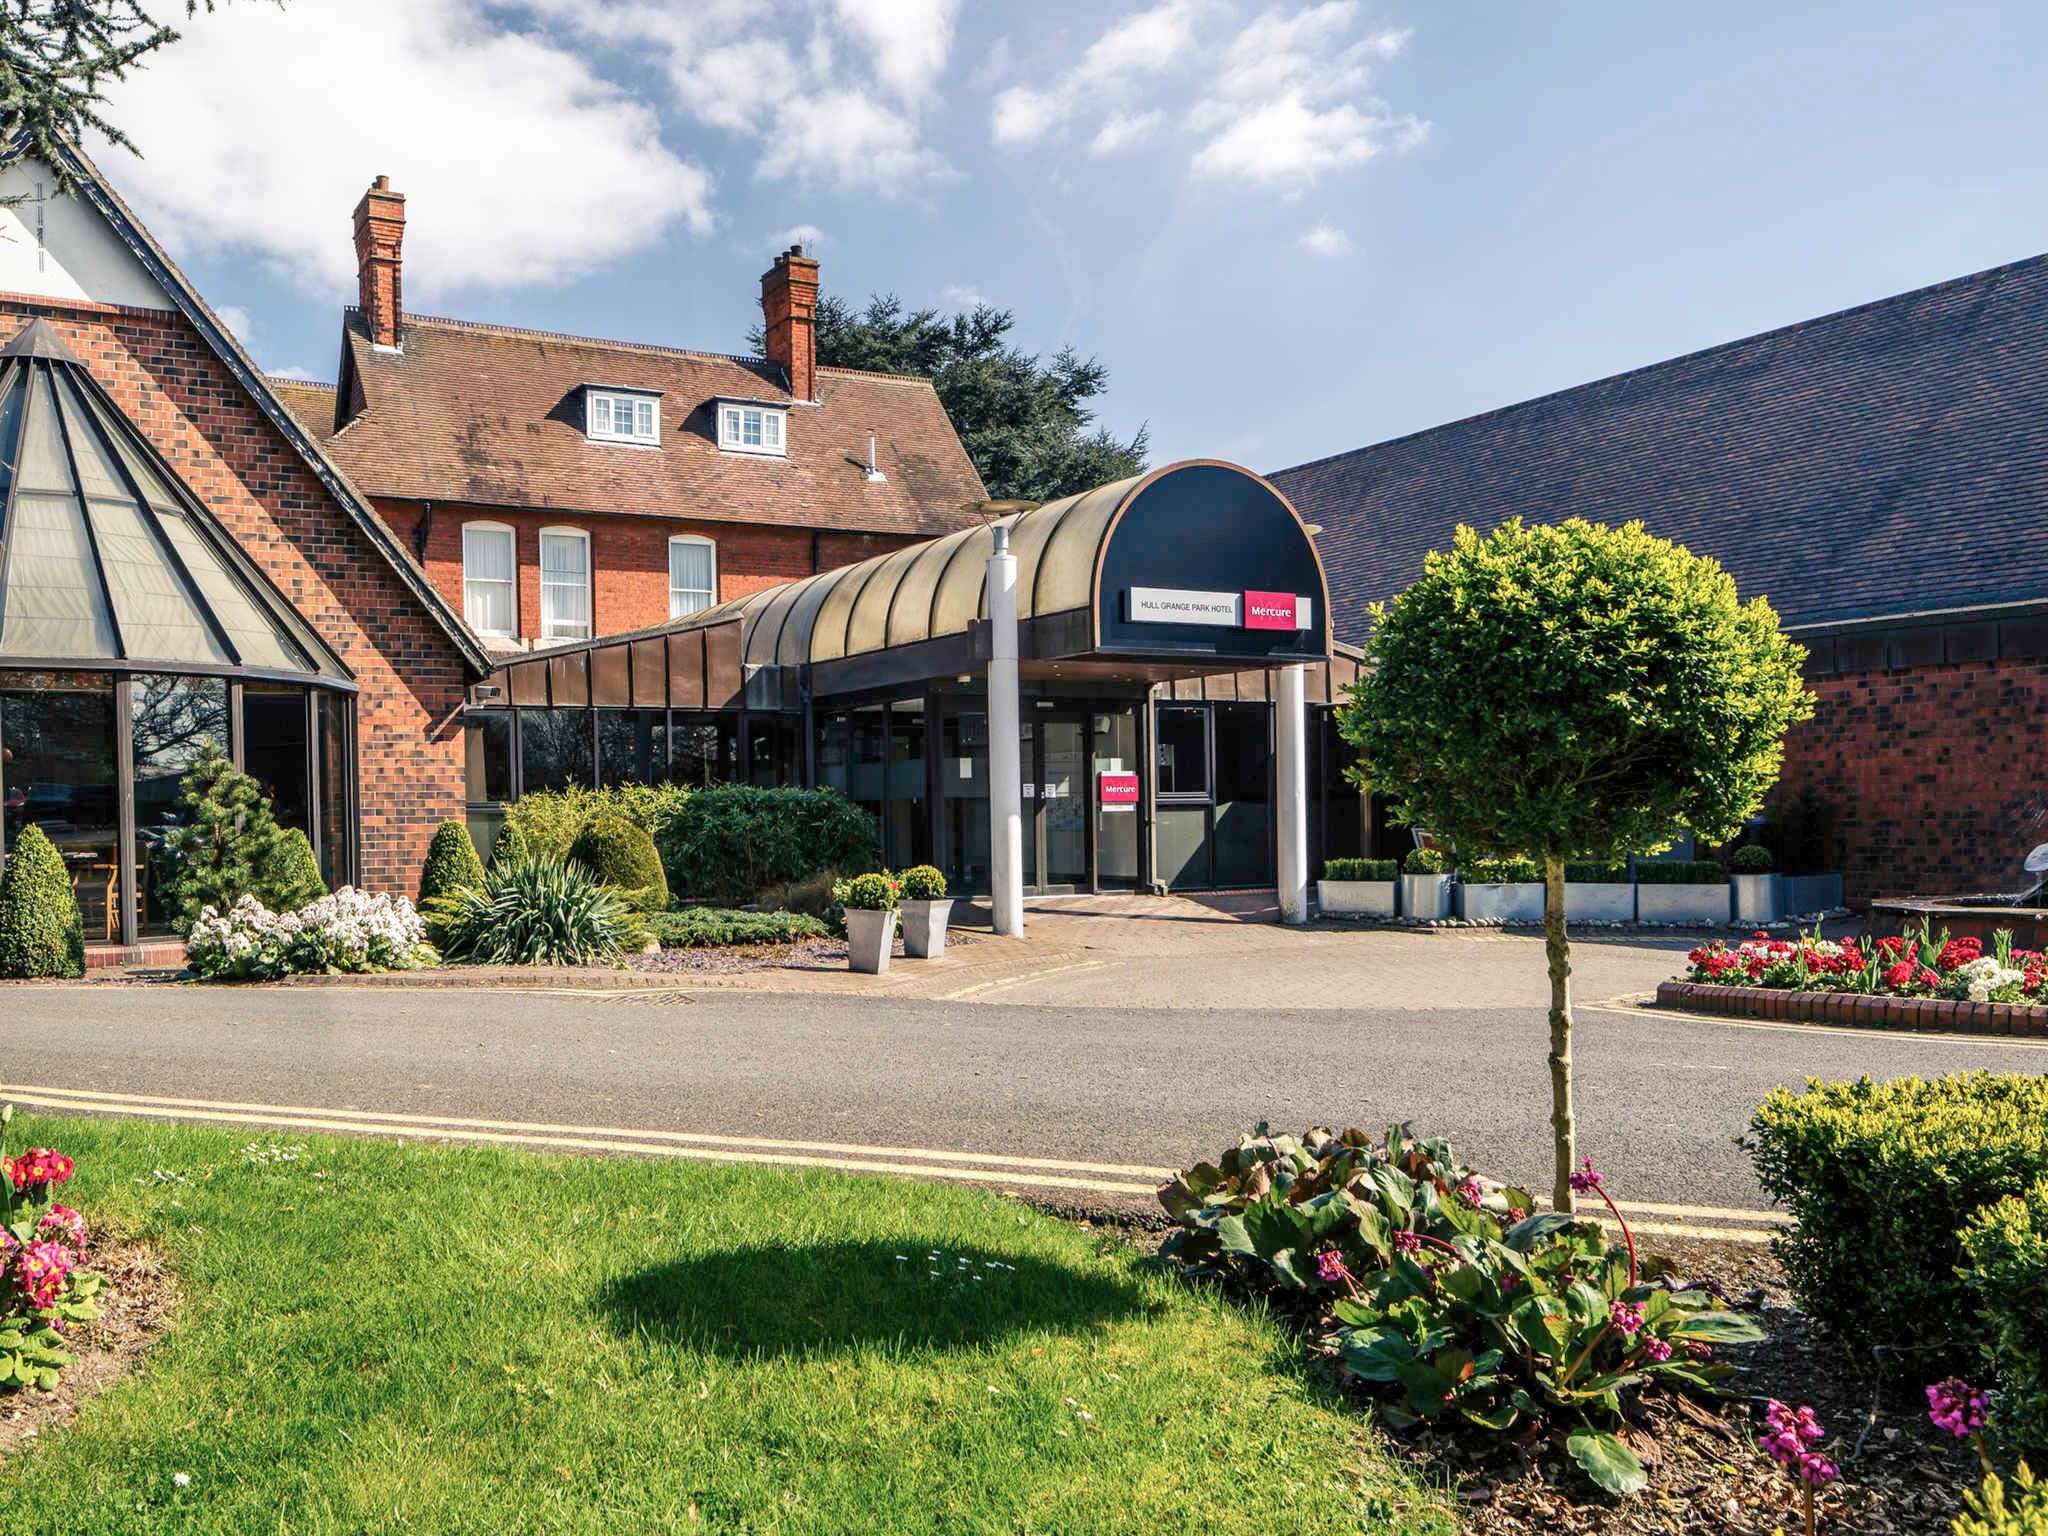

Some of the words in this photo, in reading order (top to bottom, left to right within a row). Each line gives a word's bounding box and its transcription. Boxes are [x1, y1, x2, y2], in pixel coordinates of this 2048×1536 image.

[1141, 600, 1160, 610] HULL
[1160, 602, 1190, 611] GRANGE
[1192, 603, 1210, 612] PARK
[1211, 605, 1233, 614] HOTEL
[1251, 606, 1292, 617] Mercure
[1105, 785, 1136, 793] Mercure
